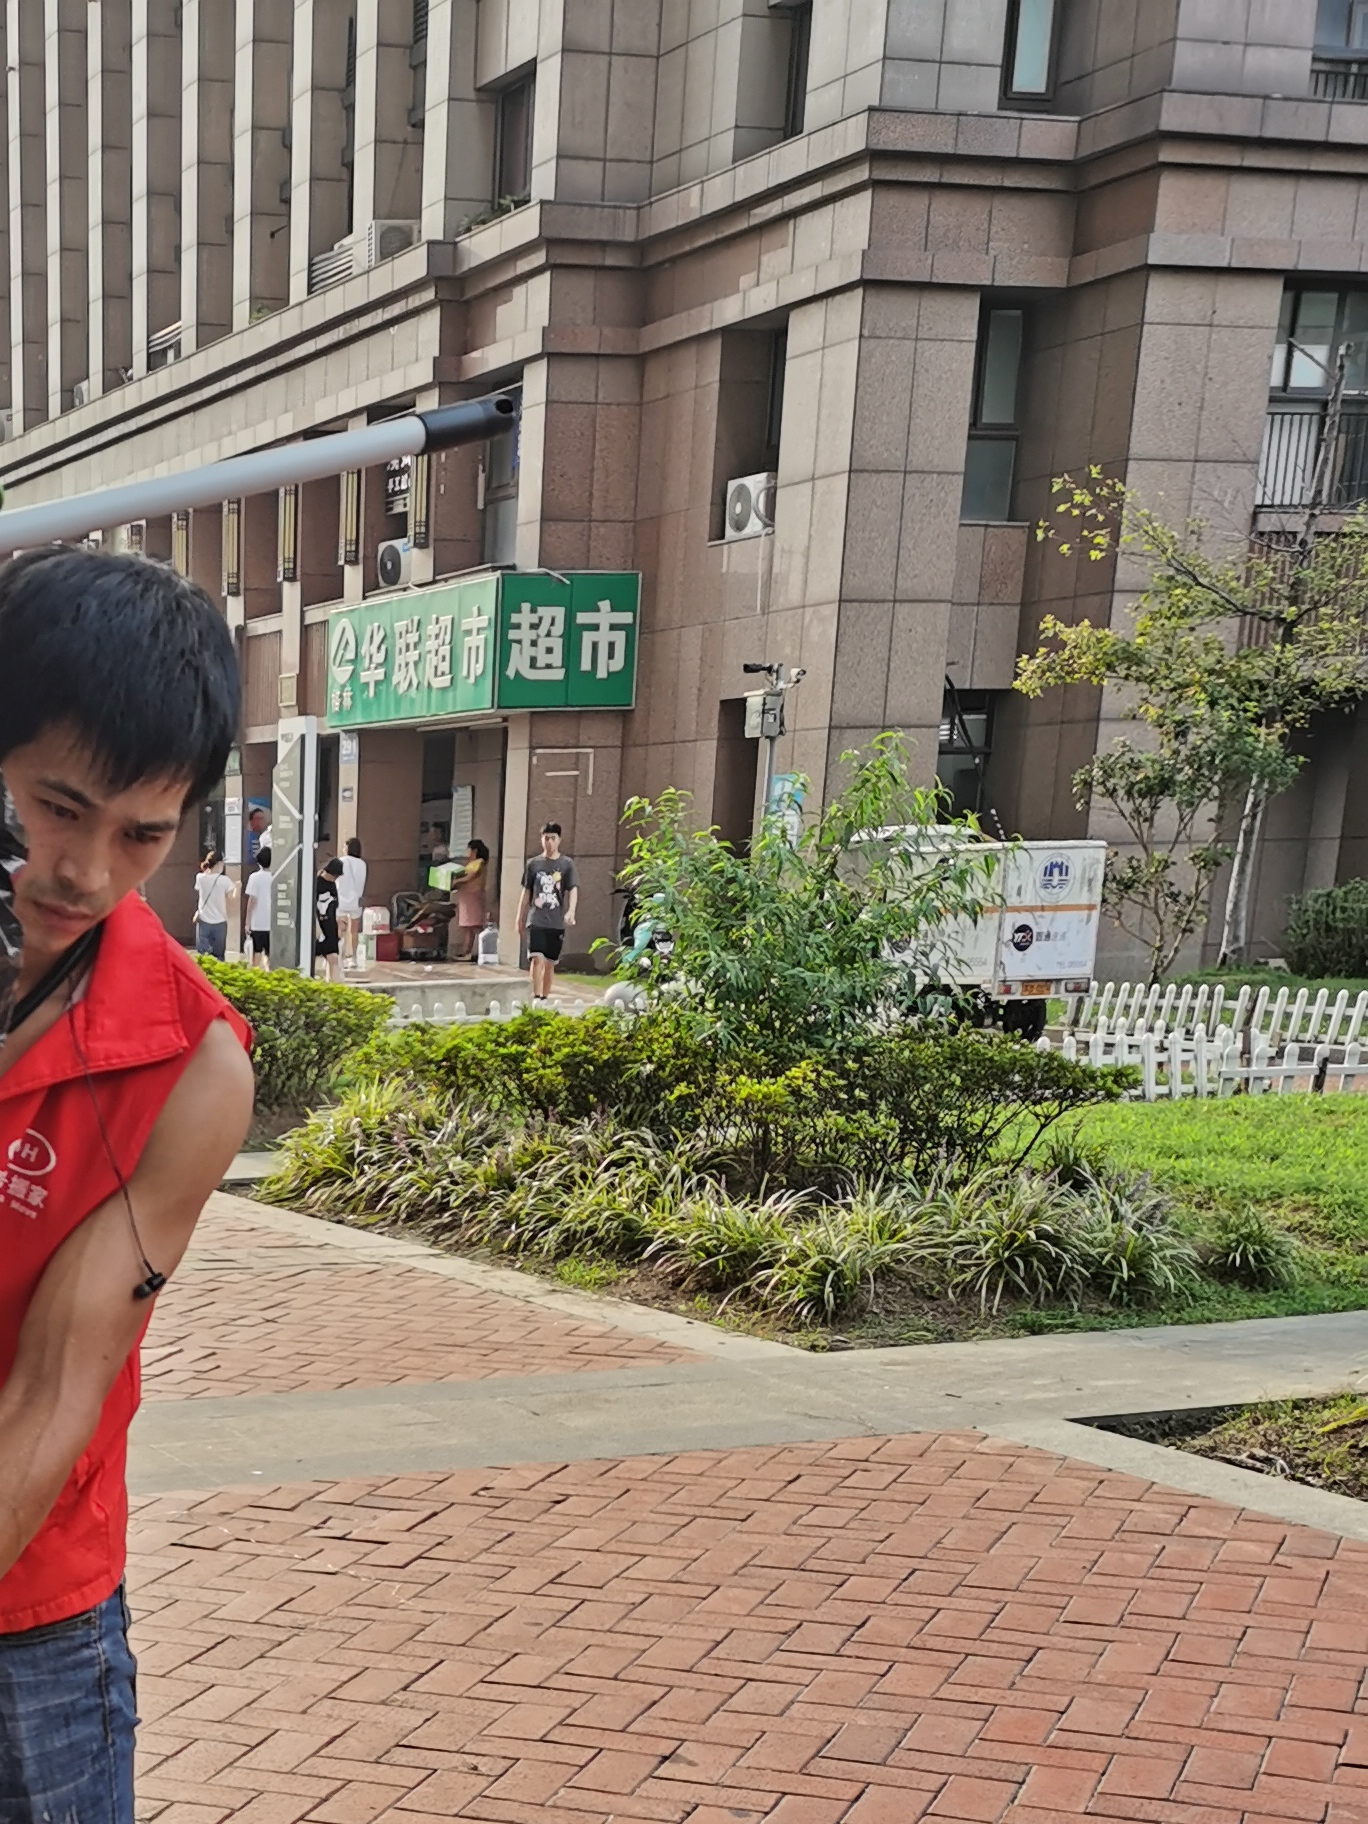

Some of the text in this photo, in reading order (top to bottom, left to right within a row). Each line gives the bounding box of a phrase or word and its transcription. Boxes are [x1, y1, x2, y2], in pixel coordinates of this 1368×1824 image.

[360, 604, 491, 698] 华联超市
[505, 599, 634, 681] 超市
